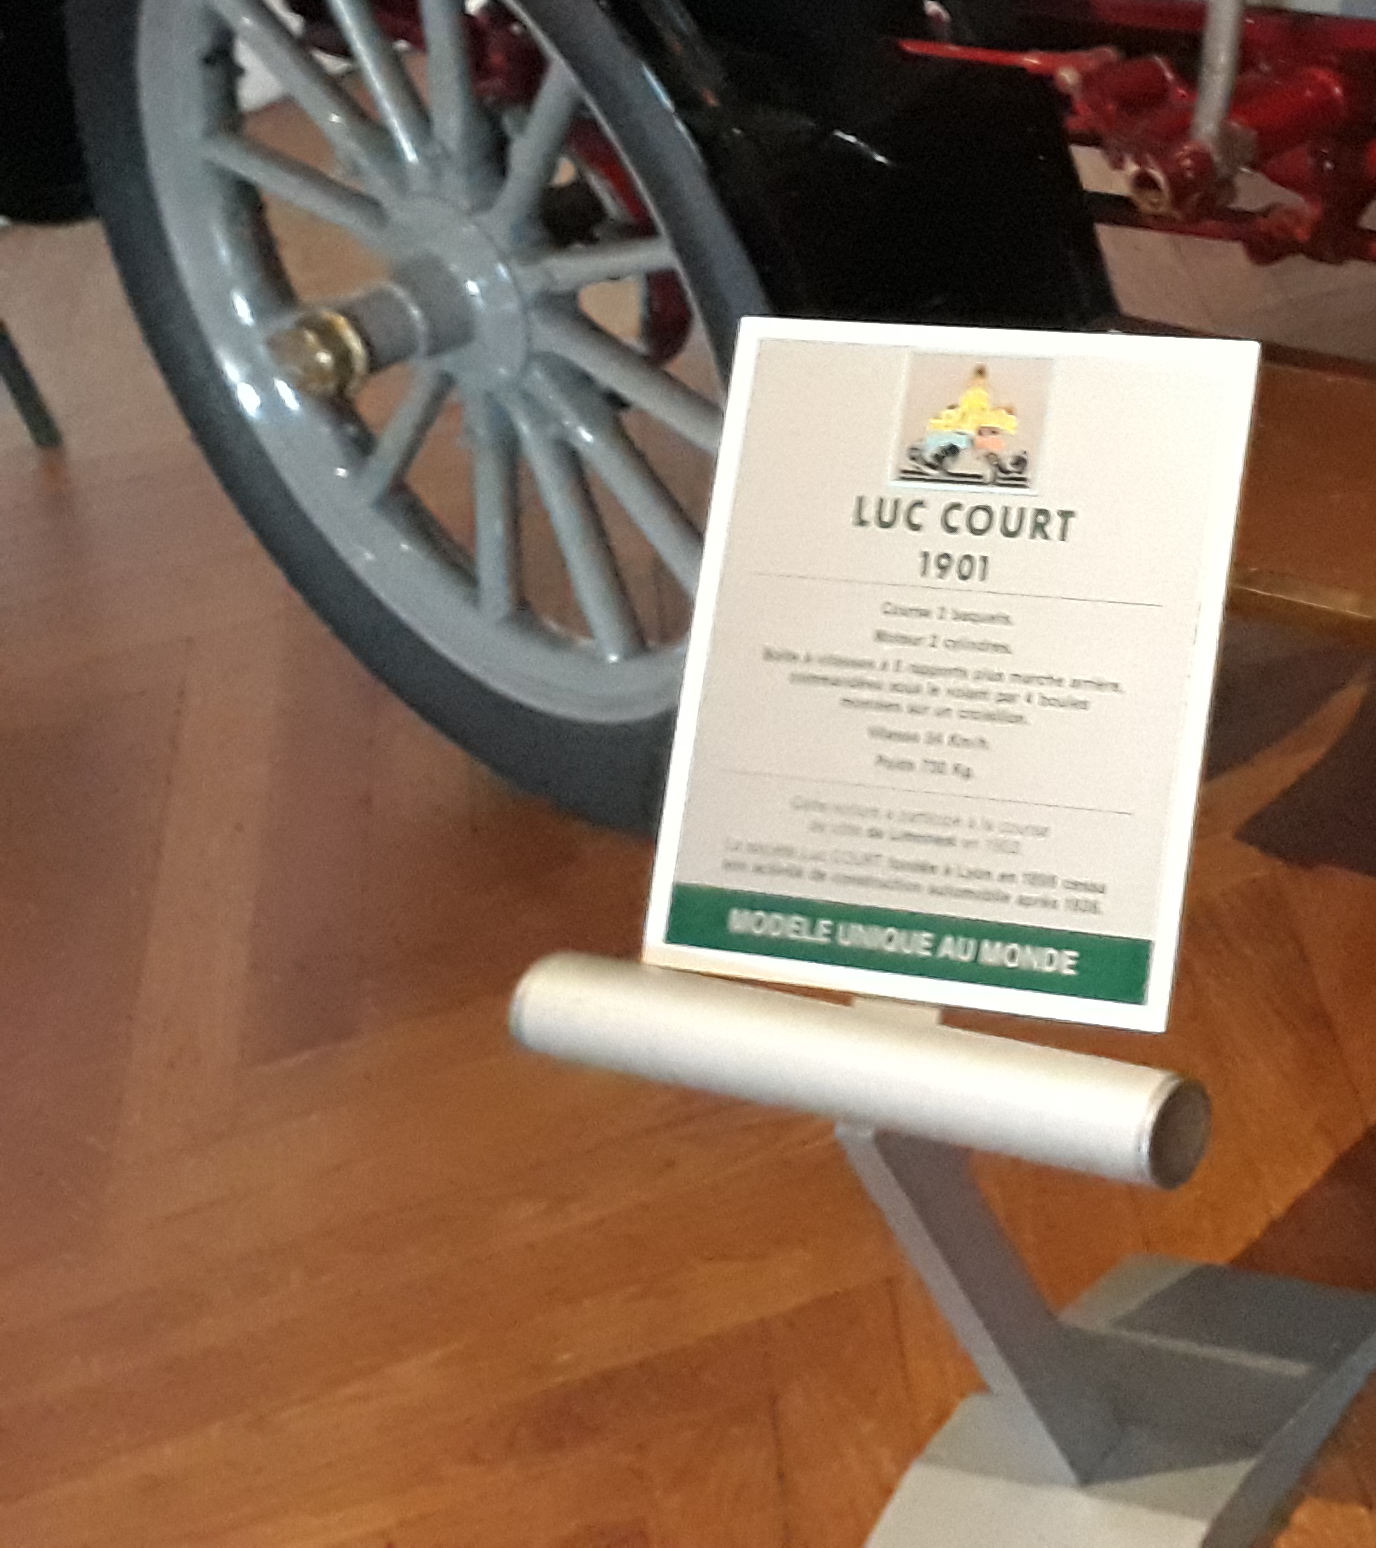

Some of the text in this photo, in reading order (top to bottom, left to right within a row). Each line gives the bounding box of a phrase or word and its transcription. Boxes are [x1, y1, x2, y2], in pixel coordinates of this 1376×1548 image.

[852, 495, 1077, 542] LUC COURT
[919, 550, 990, 582] 1901
[836, 919, 936, 958] UNIQUE
[936, 933, 976, 964] AU
[977, 937, 1081, 977] MONDE
